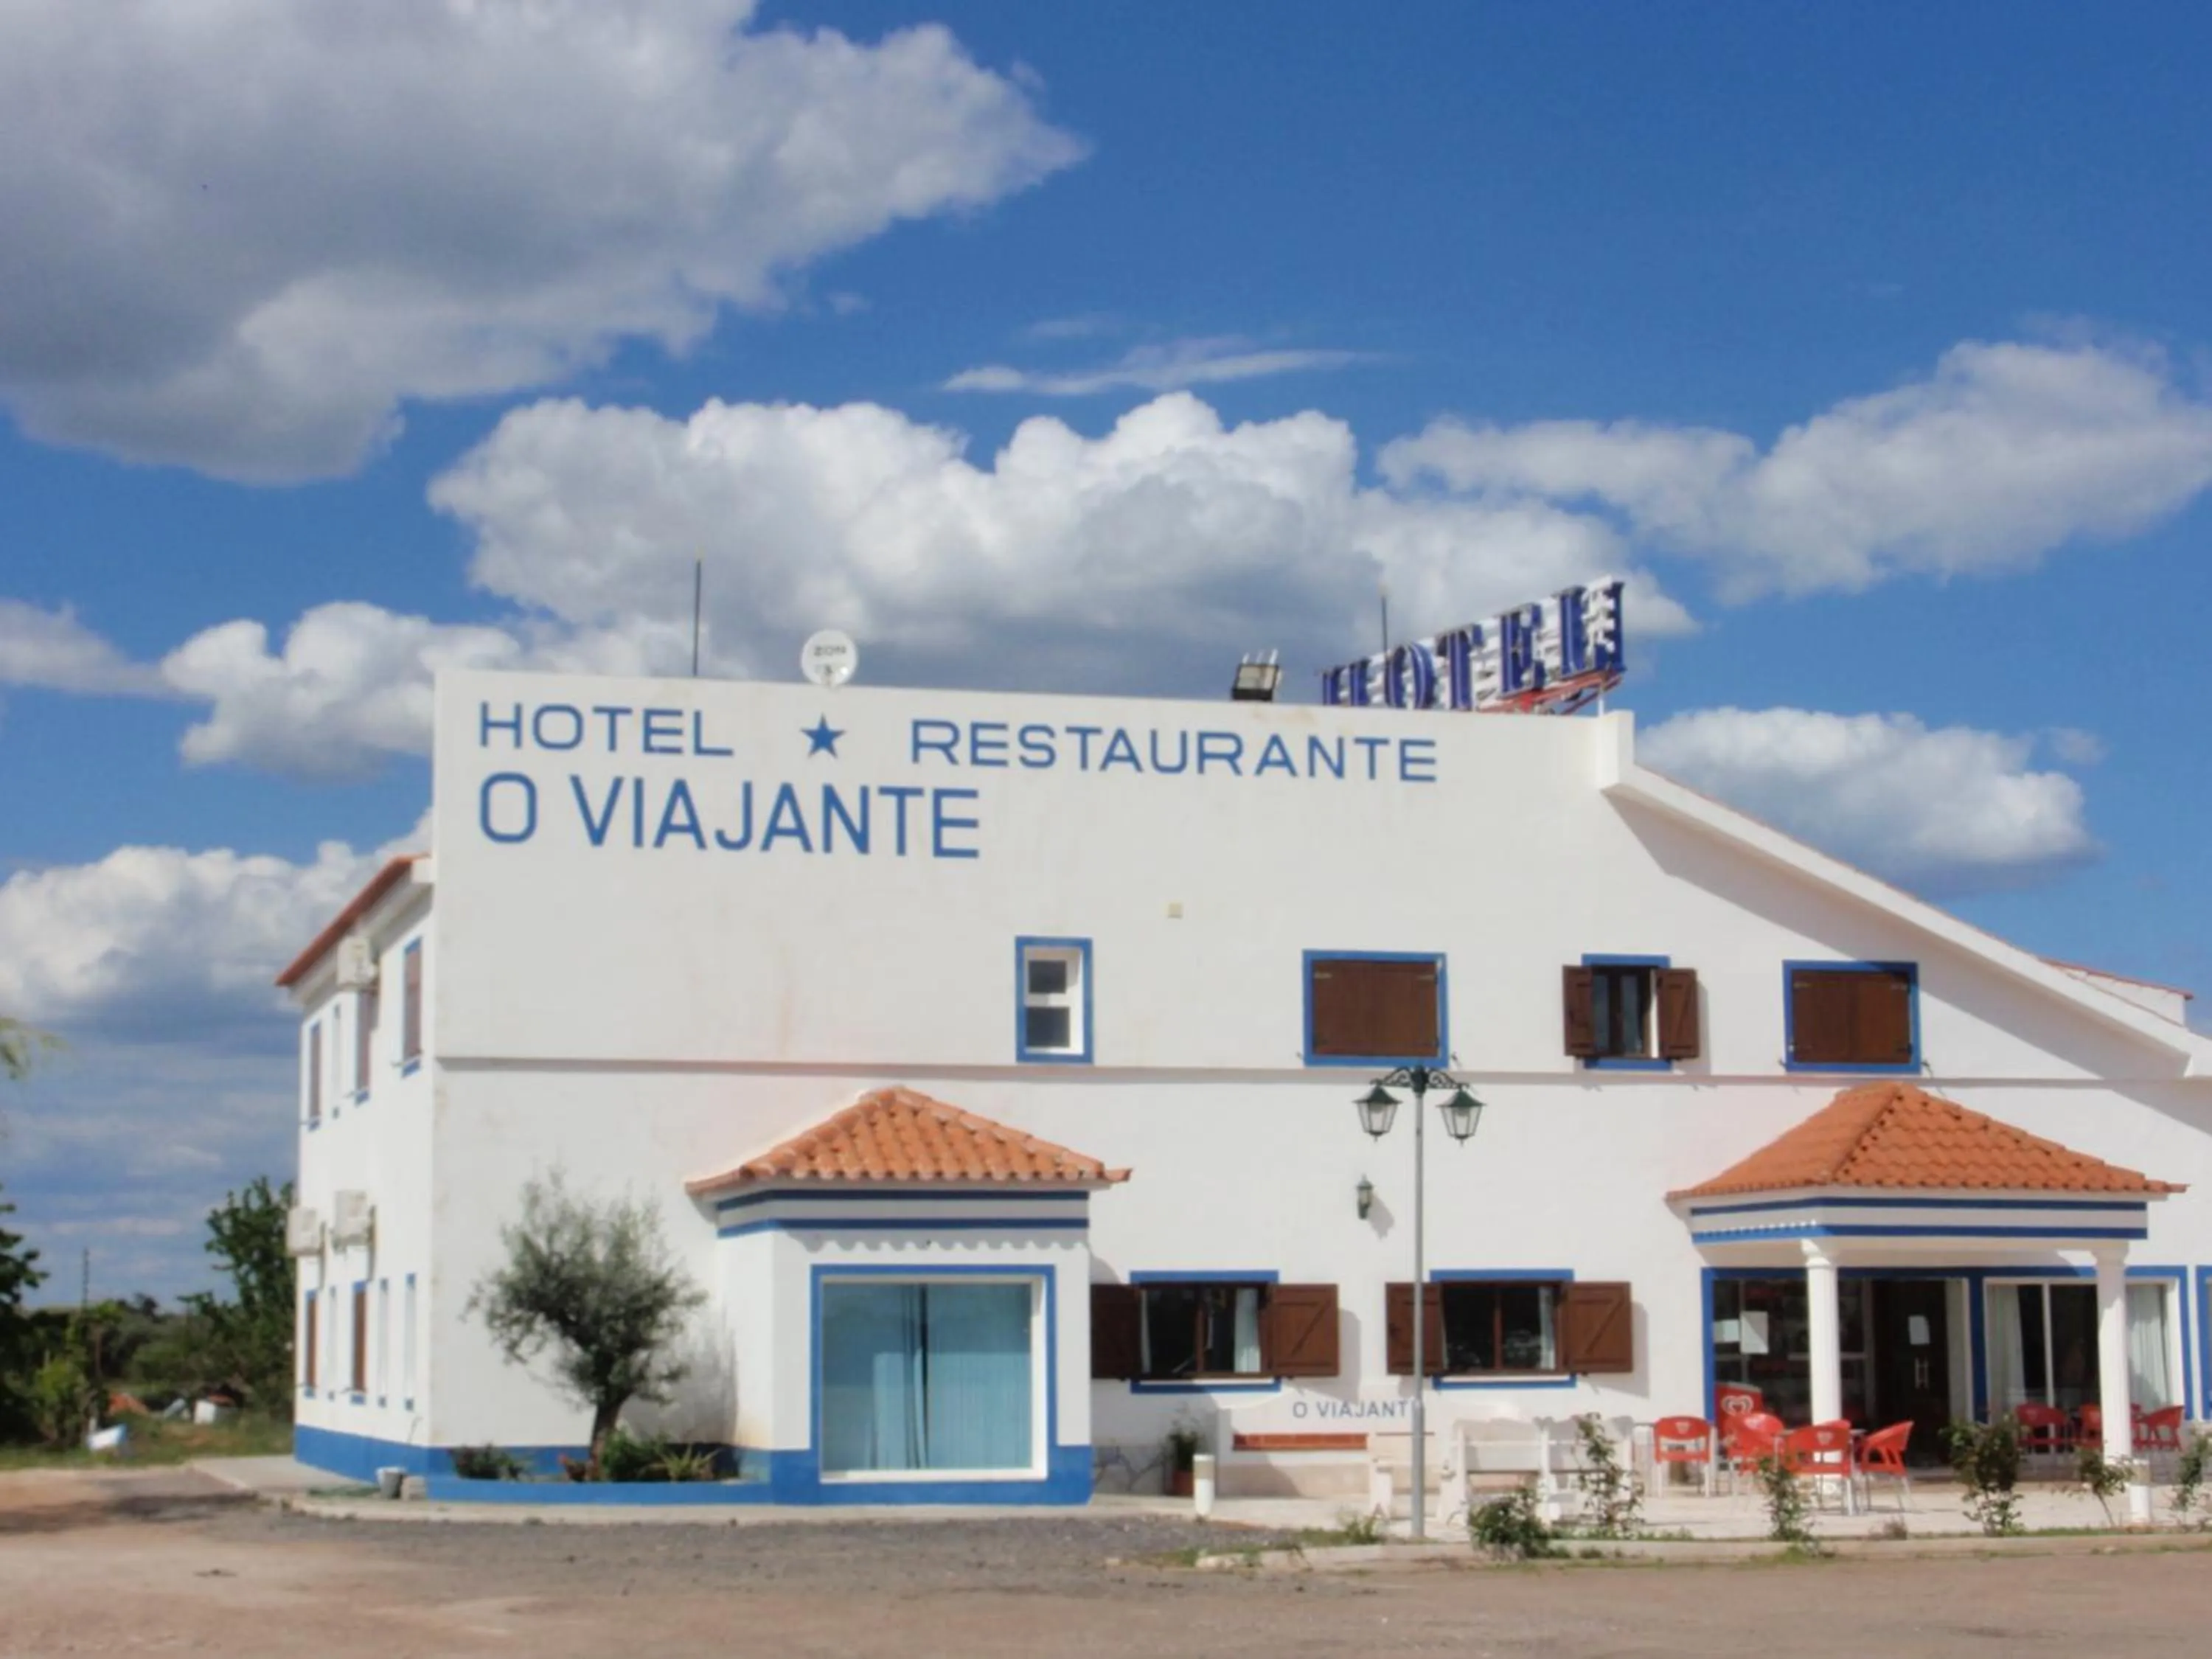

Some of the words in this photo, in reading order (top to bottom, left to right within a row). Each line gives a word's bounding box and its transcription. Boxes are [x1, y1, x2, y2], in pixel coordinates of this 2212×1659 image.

[479, 701, 734, 757] HOTEL
[911, 719, 1437, 782] RESTAURANTE
[479, 772, 538, 844] O
[570, 774, 980, 858] VIAJANTE
[1292, 1402, 1308, 1419] O
[1316, 1401, 1417, 1418] VIAJANT
